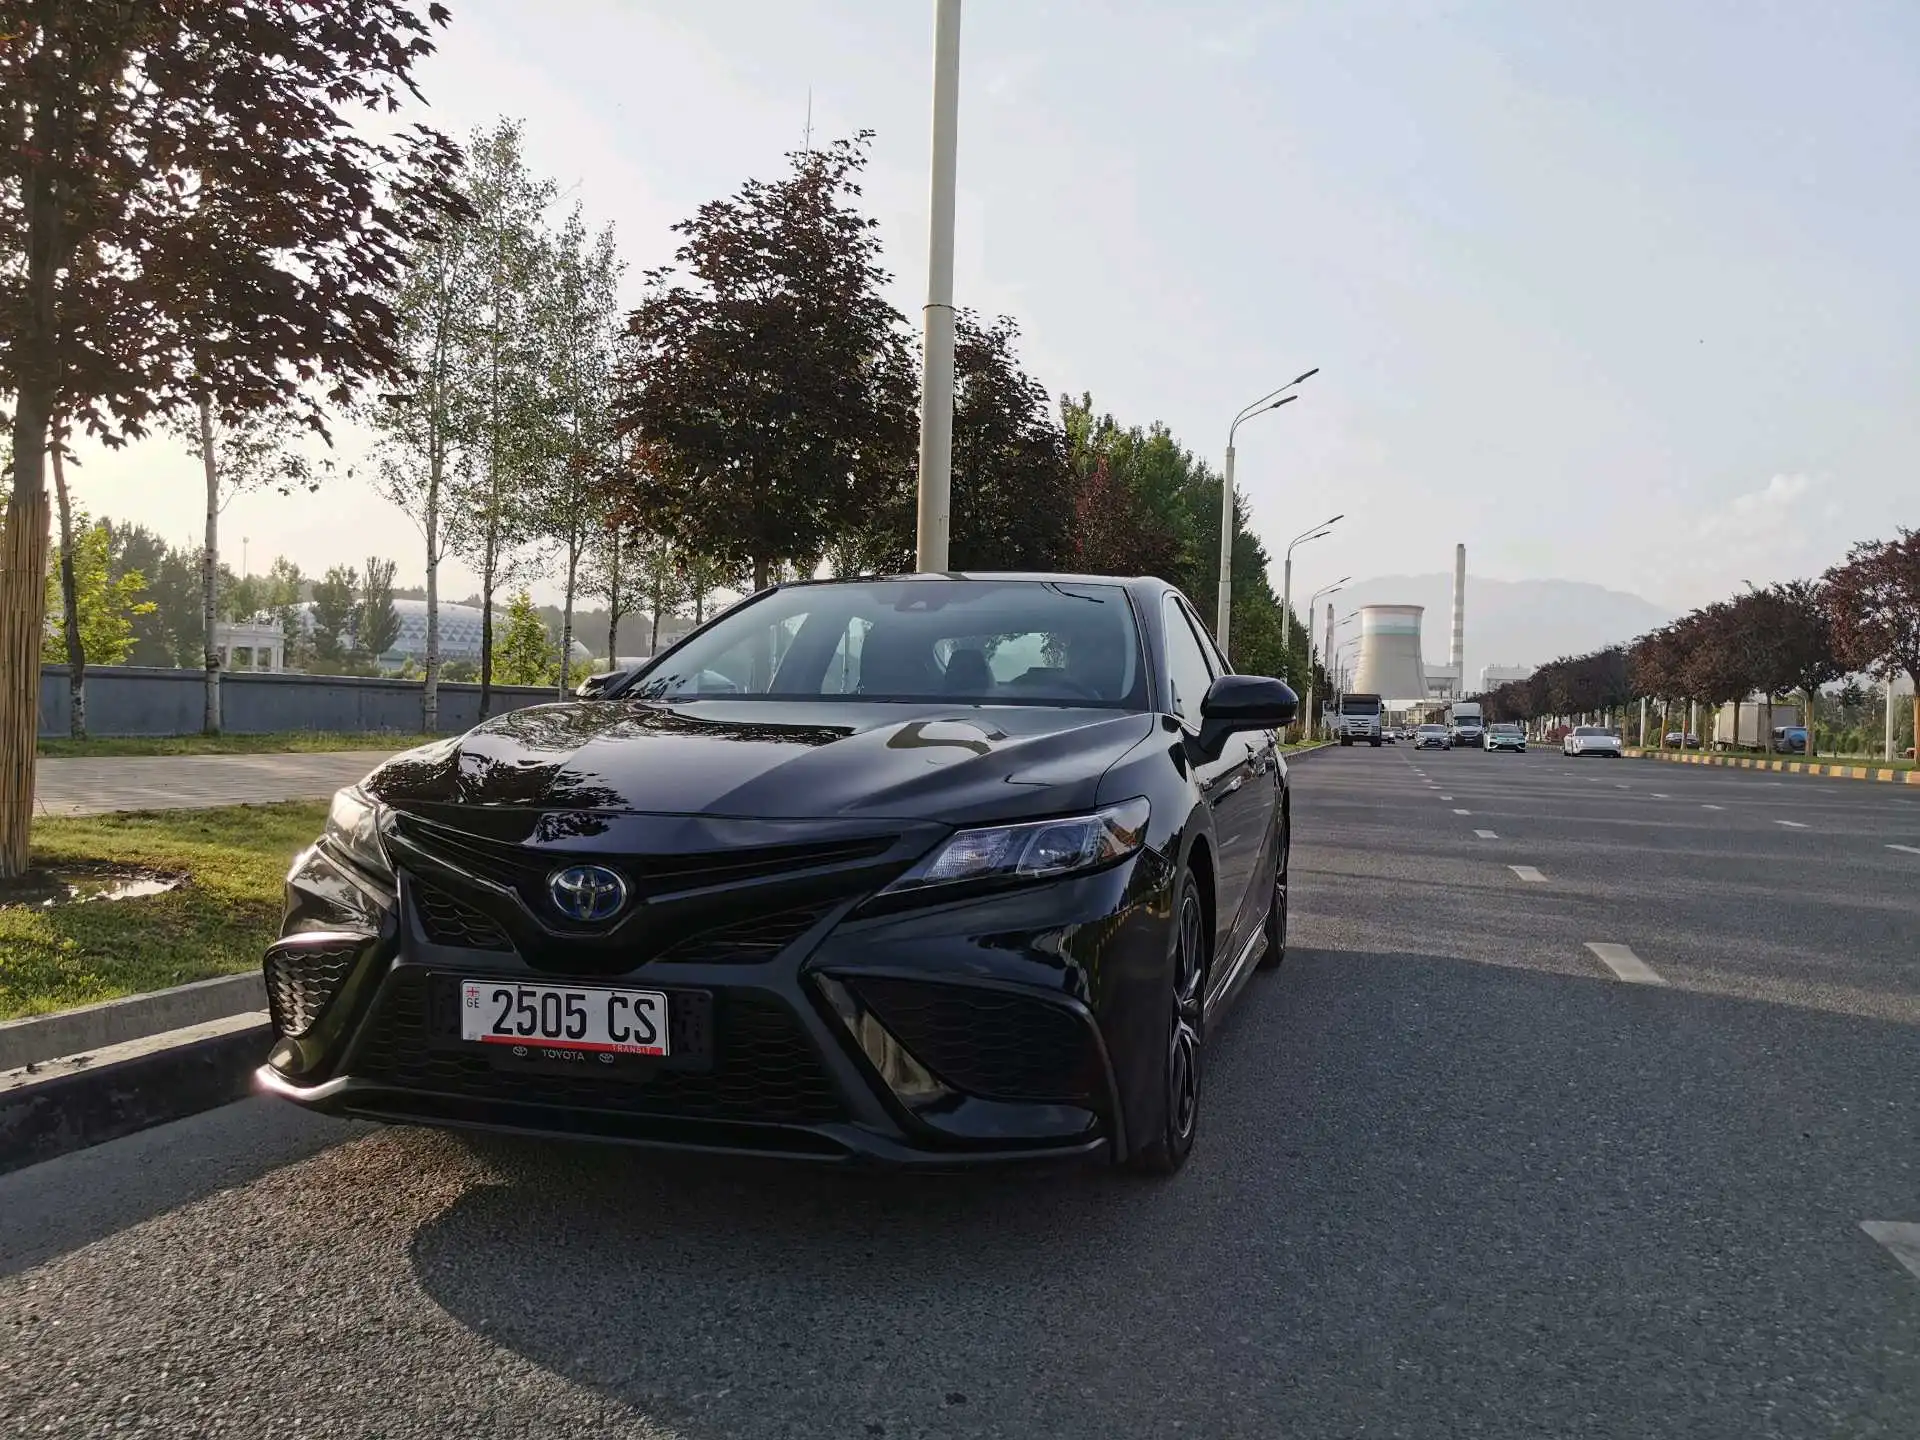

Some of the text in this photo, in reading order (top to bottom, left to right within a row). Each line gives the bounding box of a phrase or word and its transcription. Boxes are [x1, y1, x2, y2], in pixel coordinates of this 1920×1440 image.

[466, 997, 480, 1008] GE
[492, 989, 656, 1044] 2505 CS
[542, 1049, 584, 1061] TOYOTA
[612, 1044, 651, 1055] TRANSIT
